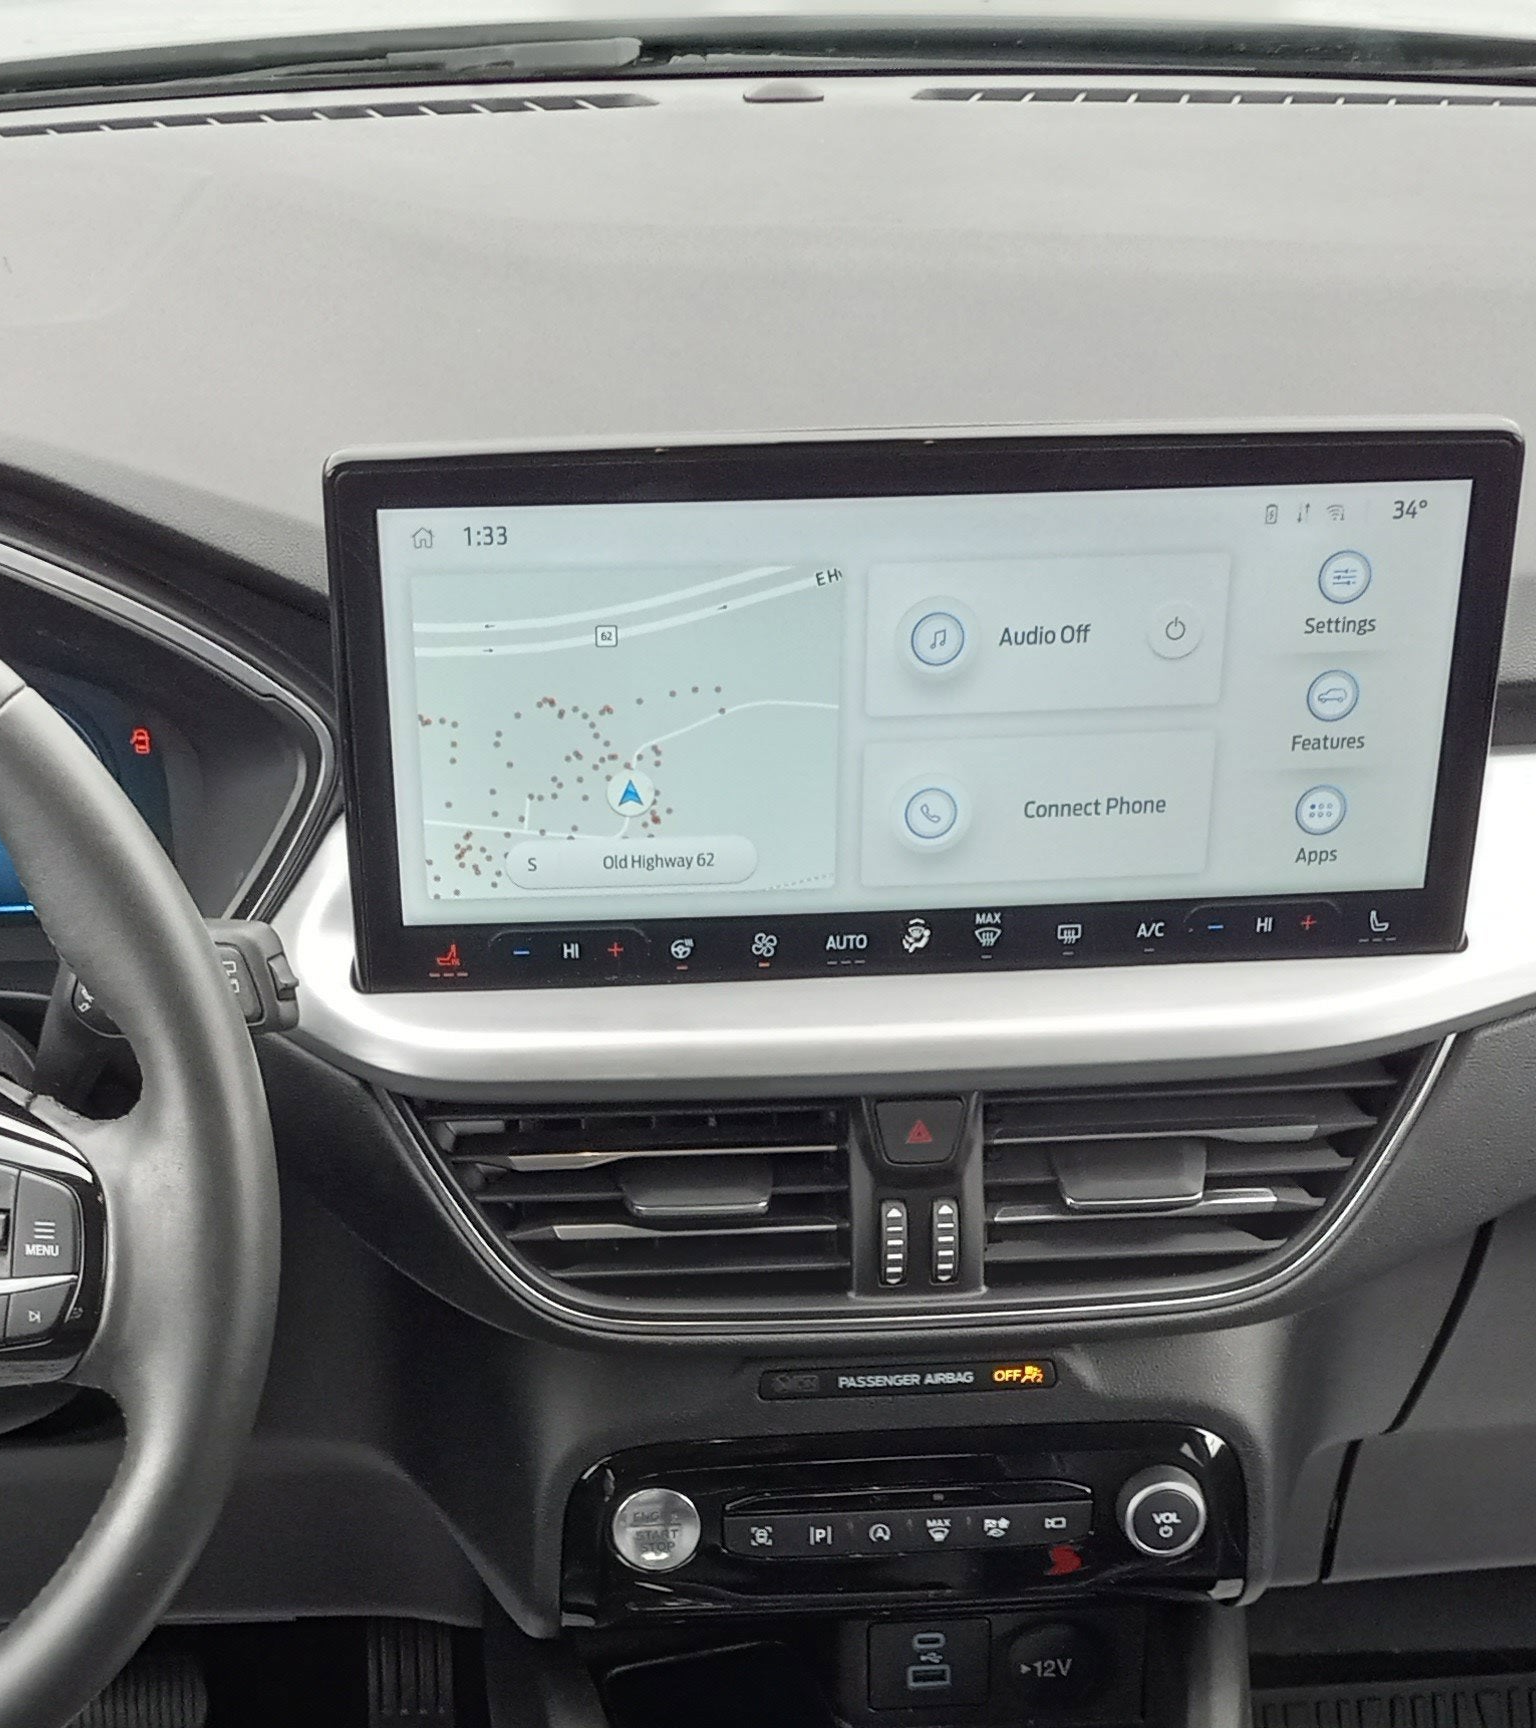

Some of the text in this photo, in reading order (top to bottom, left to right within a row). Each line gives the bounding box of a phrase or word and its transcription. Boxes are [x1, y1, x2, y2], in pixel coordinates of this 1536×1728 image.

[463, 526, 508, 546] 1:33
[1304, 616, 1376, 635] Settings
[600, 631, 613, 641] 62
[998, 623, 1091, 647] Audio Off
[1291, 734, 1365, 752] Features
[1023, 796, 1166, 819] Connect Phone
[527, 857, 538, 872] S
[602, 852, 715, 871] Old Highway 62
[1295, 847, 1337, 866] Apps
[975, 911, 1003, 926] MAX
[1255, 916, 1274, 934] HI
[1135, 921, 1165, 940] A/C
[562, 942, 580, 960] HI
[825, 933, 868, 952] AUTO
[24, 1243, 60, 1258] MENU
[838, 1369, 1022, 1390] PASSENGER AIRBAG OFF
[925, 1518, 952, 1528] MAX
[1152, 1512, 1182, 1525] VOL
[636, 1529, 679, 1540] START
[642, 1541, 676, 1552] STOP
[1034, 1658, 1072, 1678] 12V
